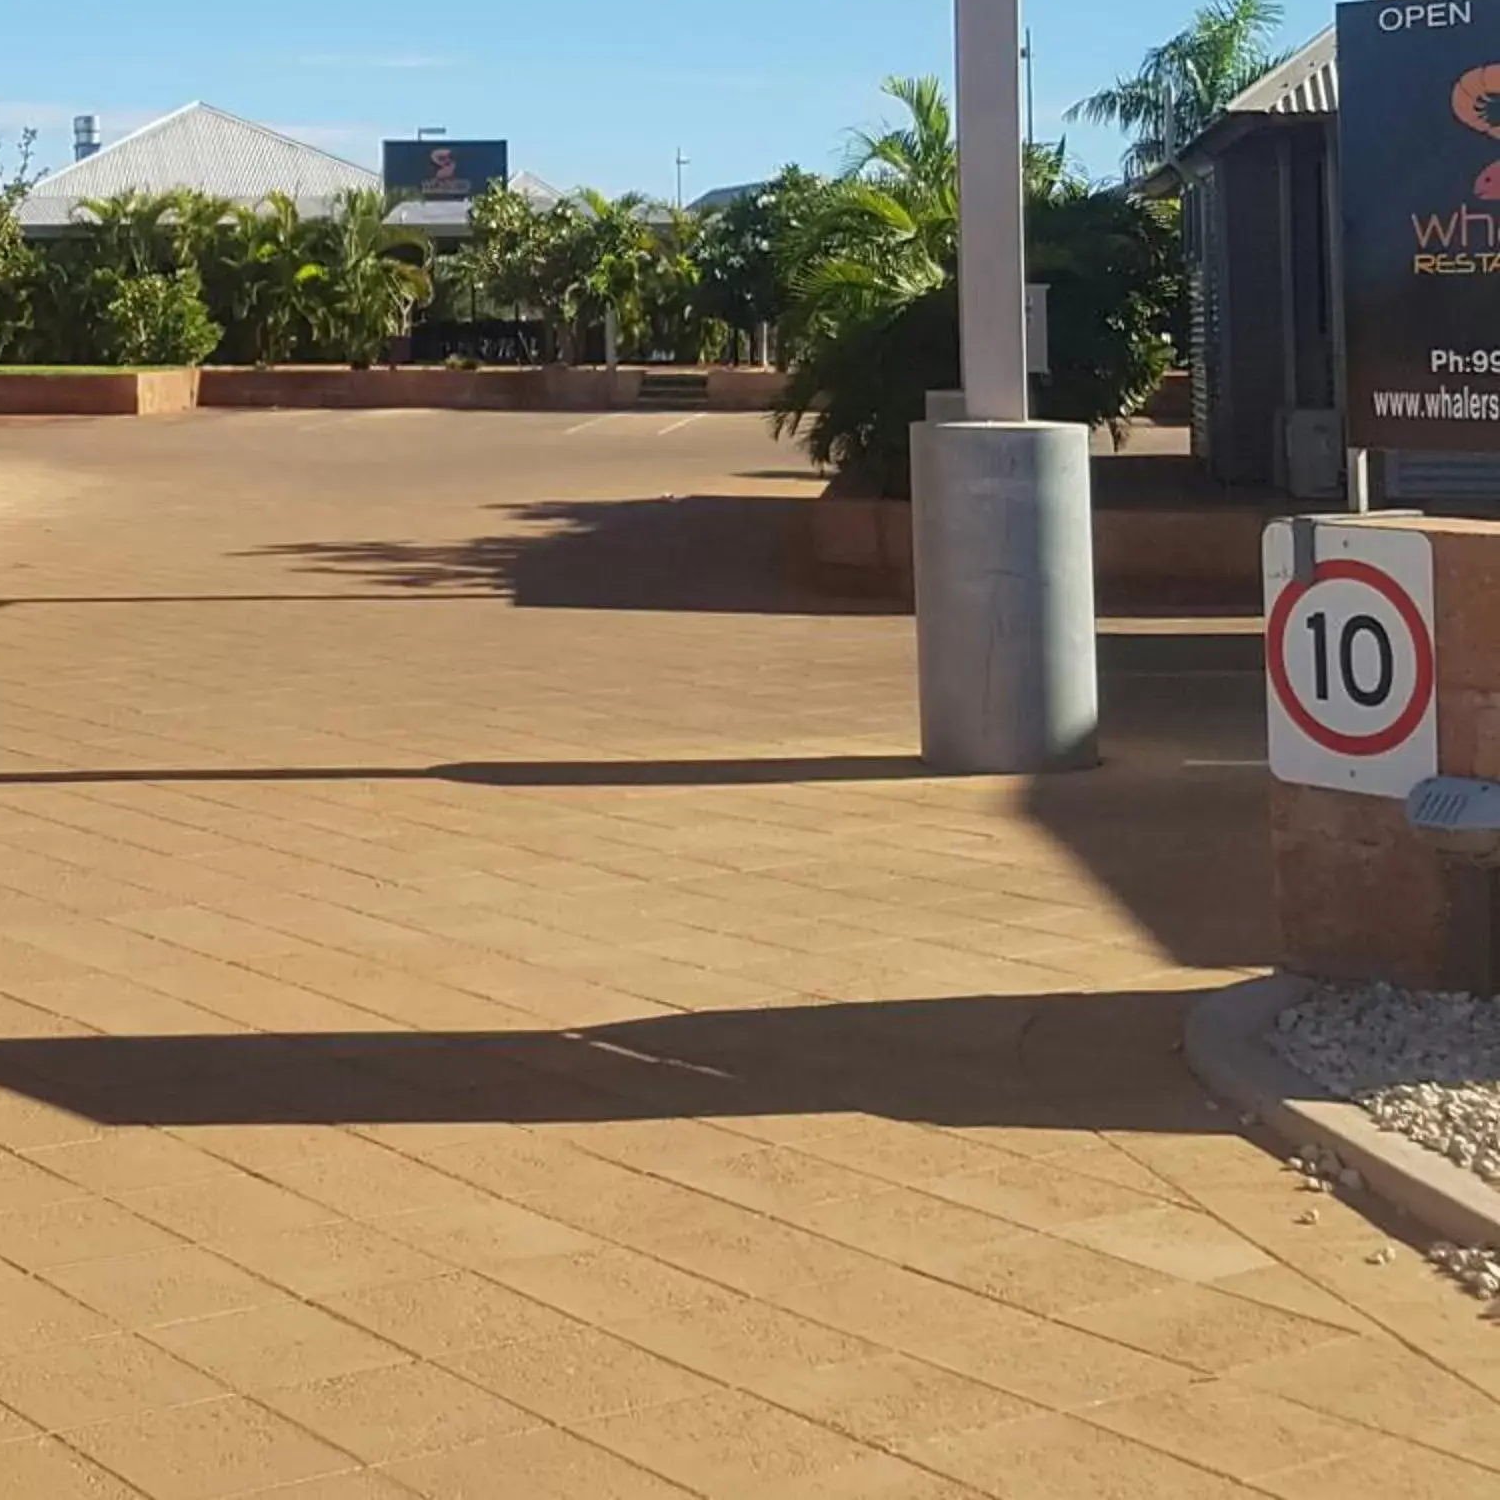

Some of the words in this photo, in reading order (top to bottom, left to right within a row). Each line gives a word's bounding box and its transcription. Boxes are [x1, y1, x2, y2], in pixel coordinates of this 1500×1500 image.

[1378, 0, 1471, 31] OPEN
[1411, 203, 1500, 248] wh
[1306, 611, 1394, 707] 10
